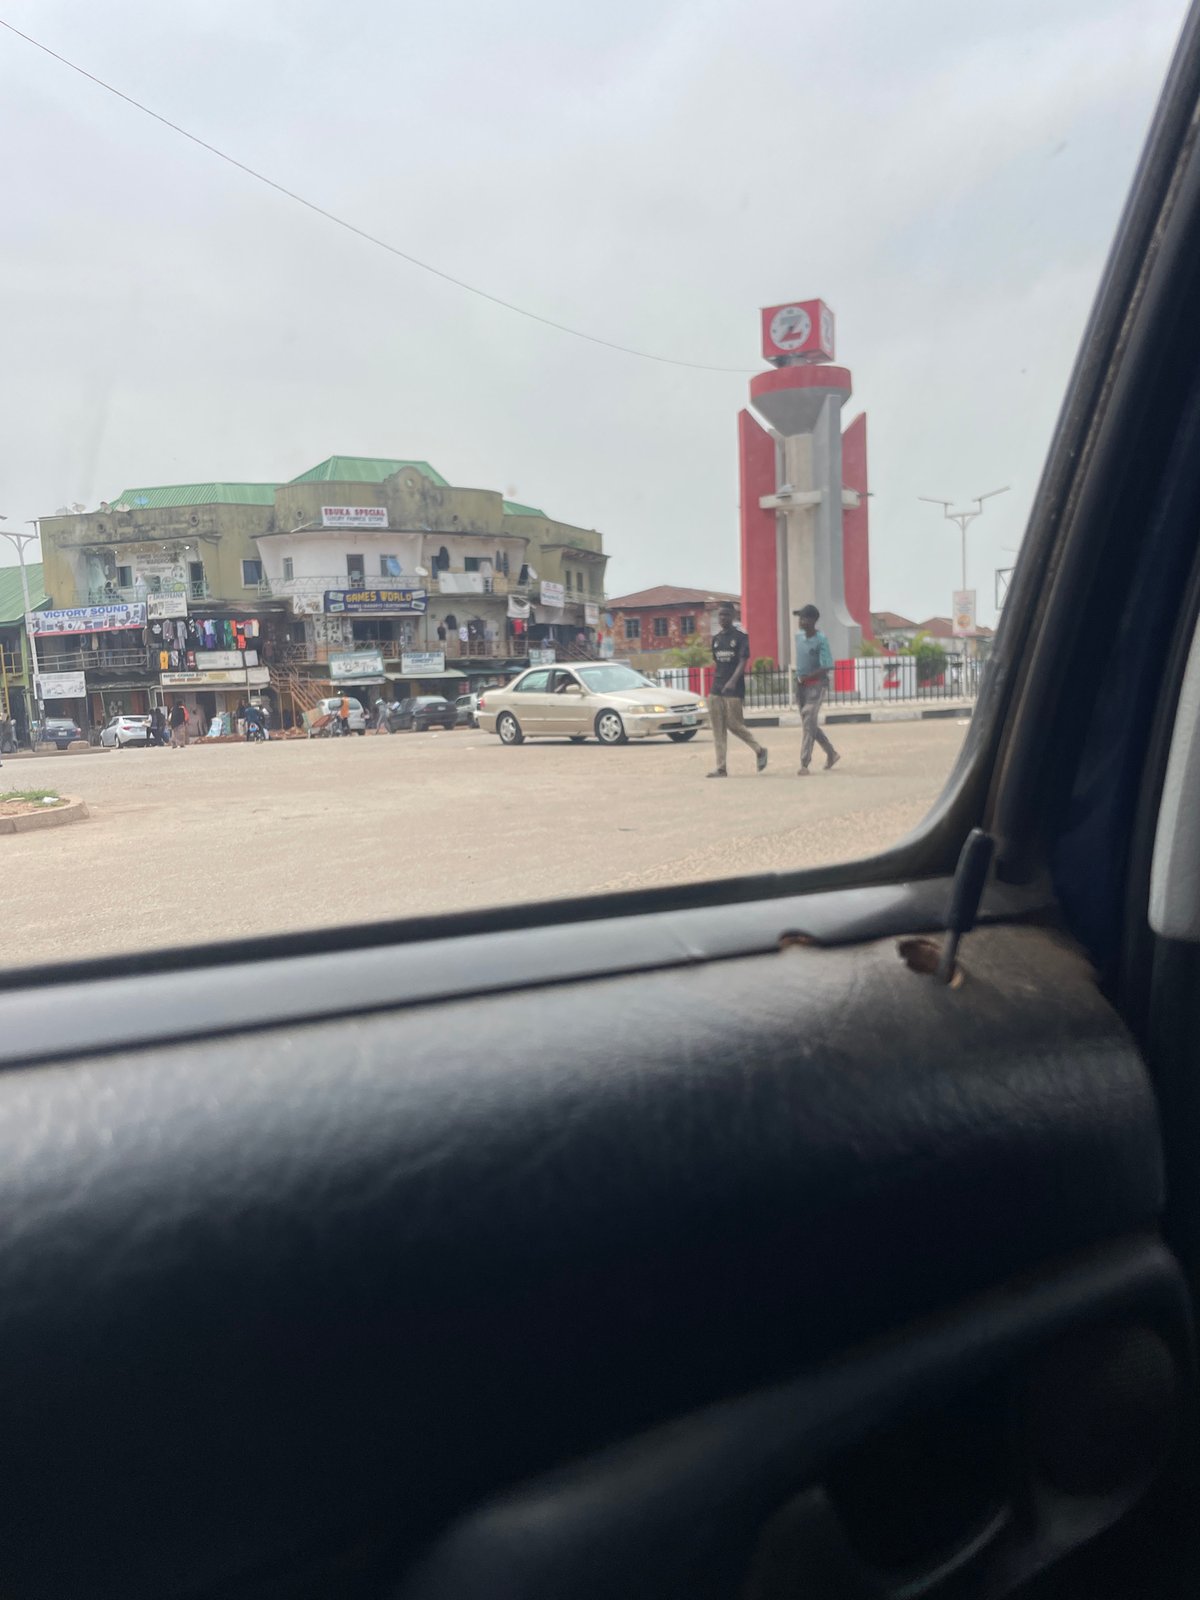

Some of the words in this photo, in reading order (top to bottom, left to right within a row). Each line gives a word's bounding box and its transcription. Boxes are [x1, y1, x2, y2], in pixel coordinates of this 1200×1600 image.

[324, 508, 350, 516] EBUKA
[355, 508, 385, 516] SPECIAL
[345, 591, 377, 602] GAMES
[380, 590, 413, 602] WORLD
[43, 608, 88, 619] VICTORY
[90, 604, 129, 616] SOUND
